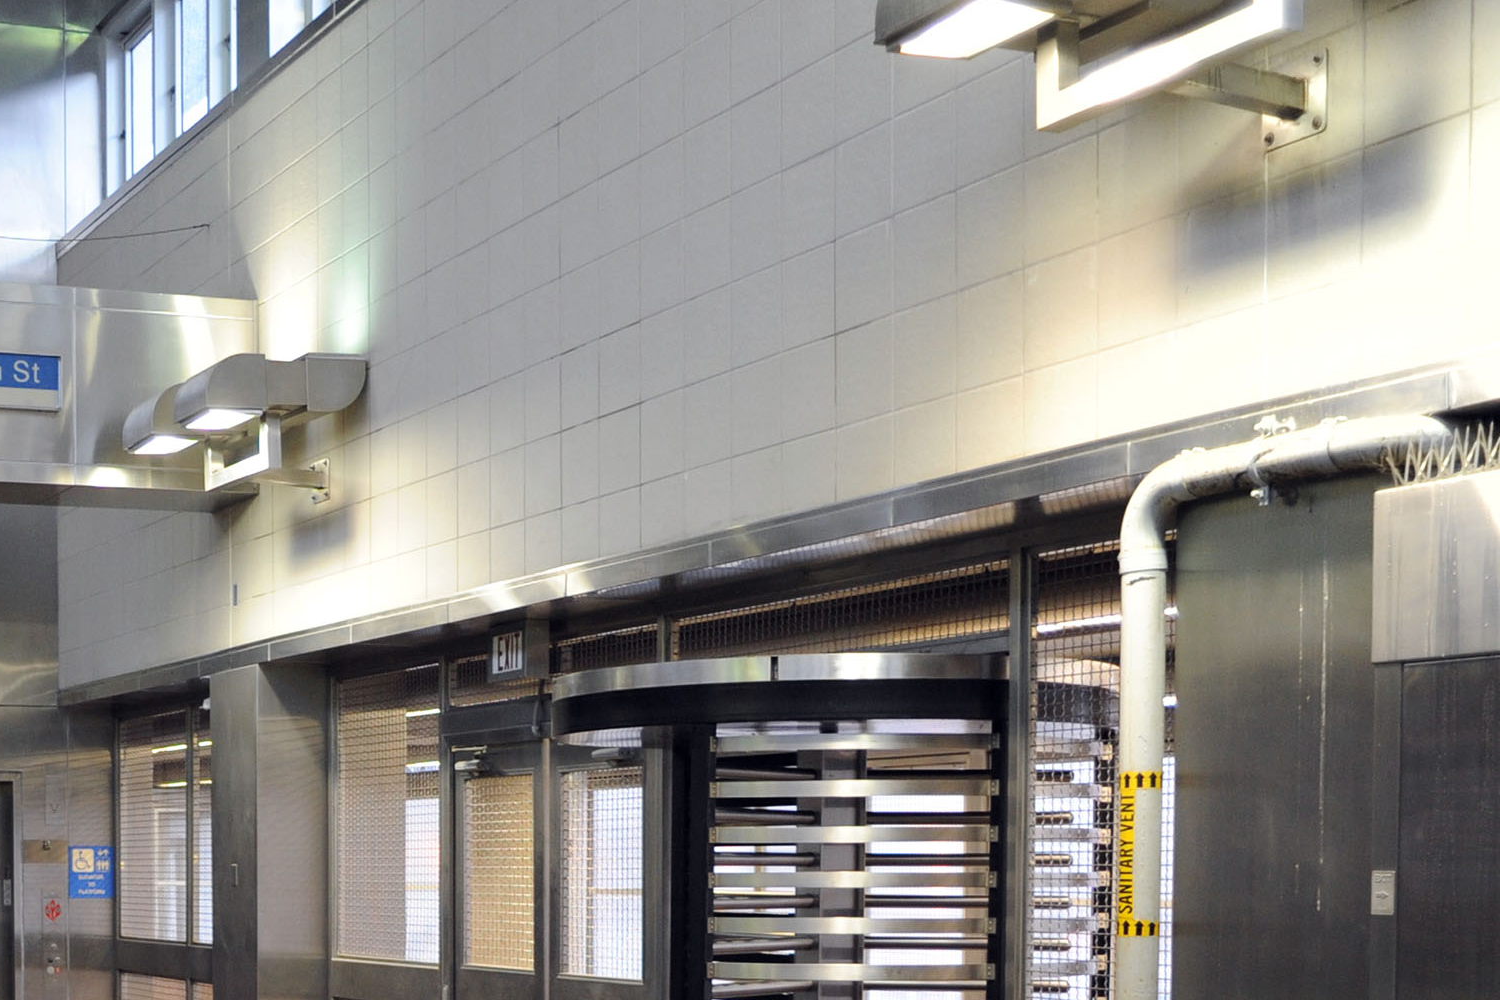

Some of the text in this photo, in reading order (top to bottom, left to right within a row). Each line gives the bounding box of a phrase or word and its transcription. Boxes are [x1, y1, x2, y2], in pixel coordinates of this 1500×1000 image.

[12, 359, 41, 384] St
[497, 633, 521, 671] EXIT
[1118, 794, 1135, 914] SANITARY VENT
